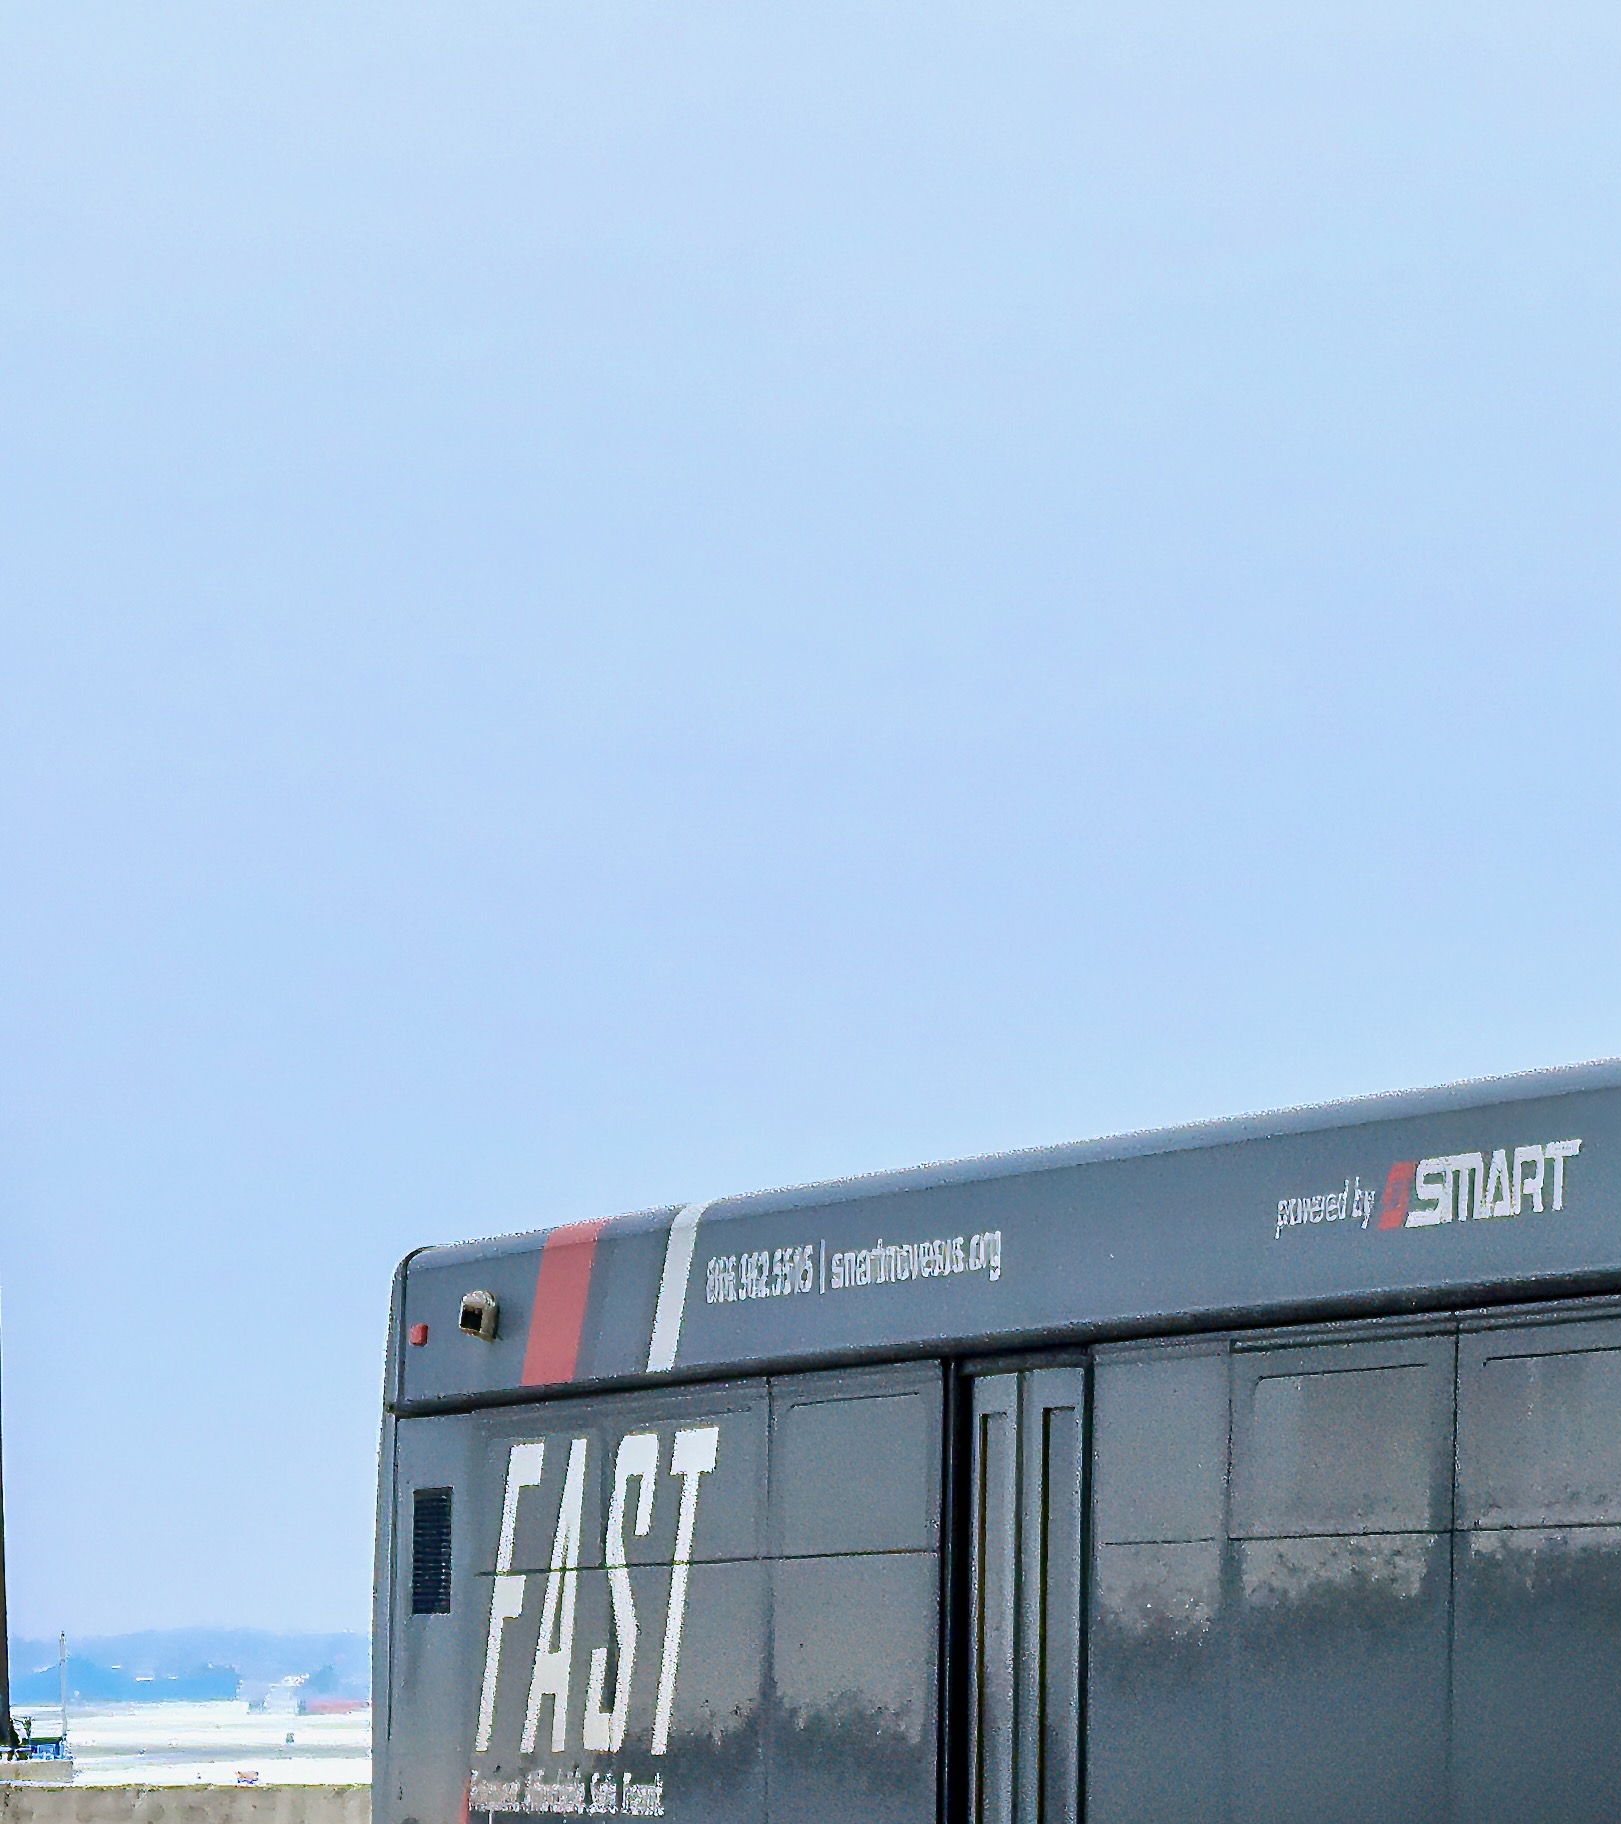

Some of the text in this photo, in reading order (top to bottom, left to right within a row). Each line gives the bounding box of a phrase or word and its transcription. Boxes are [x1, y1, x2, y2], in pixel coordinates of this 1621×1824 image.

[1275, 1139, 1582, 1239] powered by SMART
[475, 1427, 719, 1756] FAST
